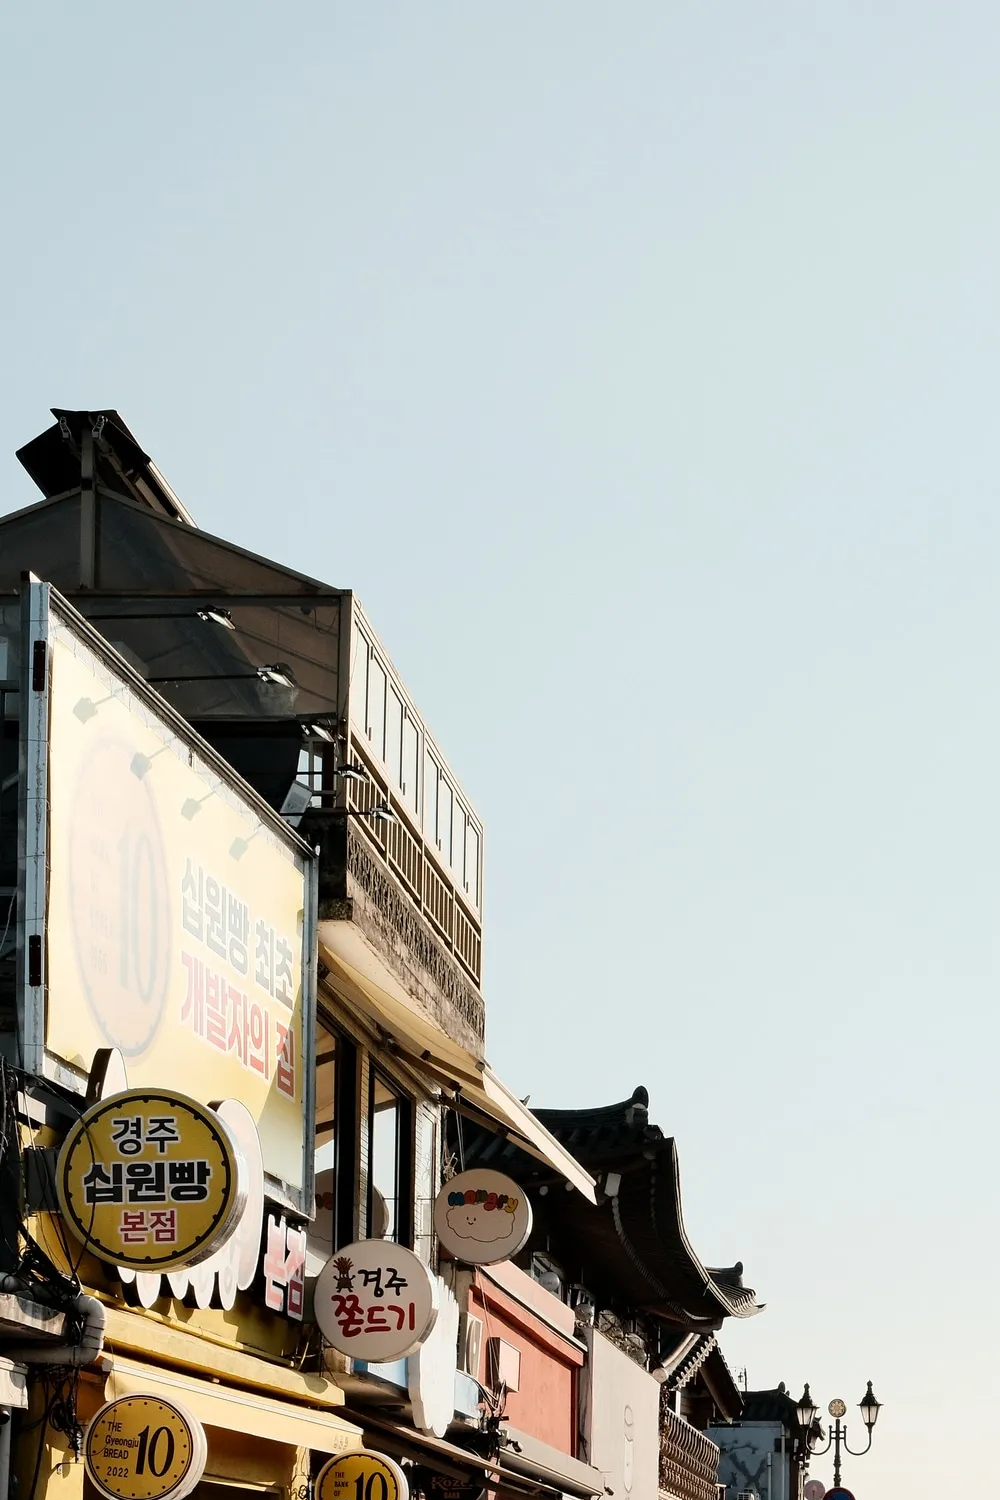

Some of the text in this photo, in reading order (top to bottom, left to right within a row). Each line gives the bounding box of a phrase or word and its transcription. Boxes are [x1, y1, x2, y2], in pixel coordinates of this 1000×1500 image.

[117, 820, 158, 1005] 10
[181, 858, 294, 1010] 십원빵 최초
[181, 954, 295, 1098] 개발자의 집
[112, 1117, 178, 1154] 경주
[83, 1161, 211, 1204] 십원빵
[120, 1210, 176, 1243] 본점
[358, 1267, 408, 1298] 경주
[331, 1294, 416, 1338] 쫀드기
[105, 1434, 140, 1449] Gyeongju
[107, 1421, 123, 1433] THE
[103, 1448, 129, 1460] BREAD
[135, 1425, 174, 1477] 10
[106, 1466, 129, 1478] 2022
[334, 1471, 345, 1479] THE
[430, 1475, 471, 1490] Koze
